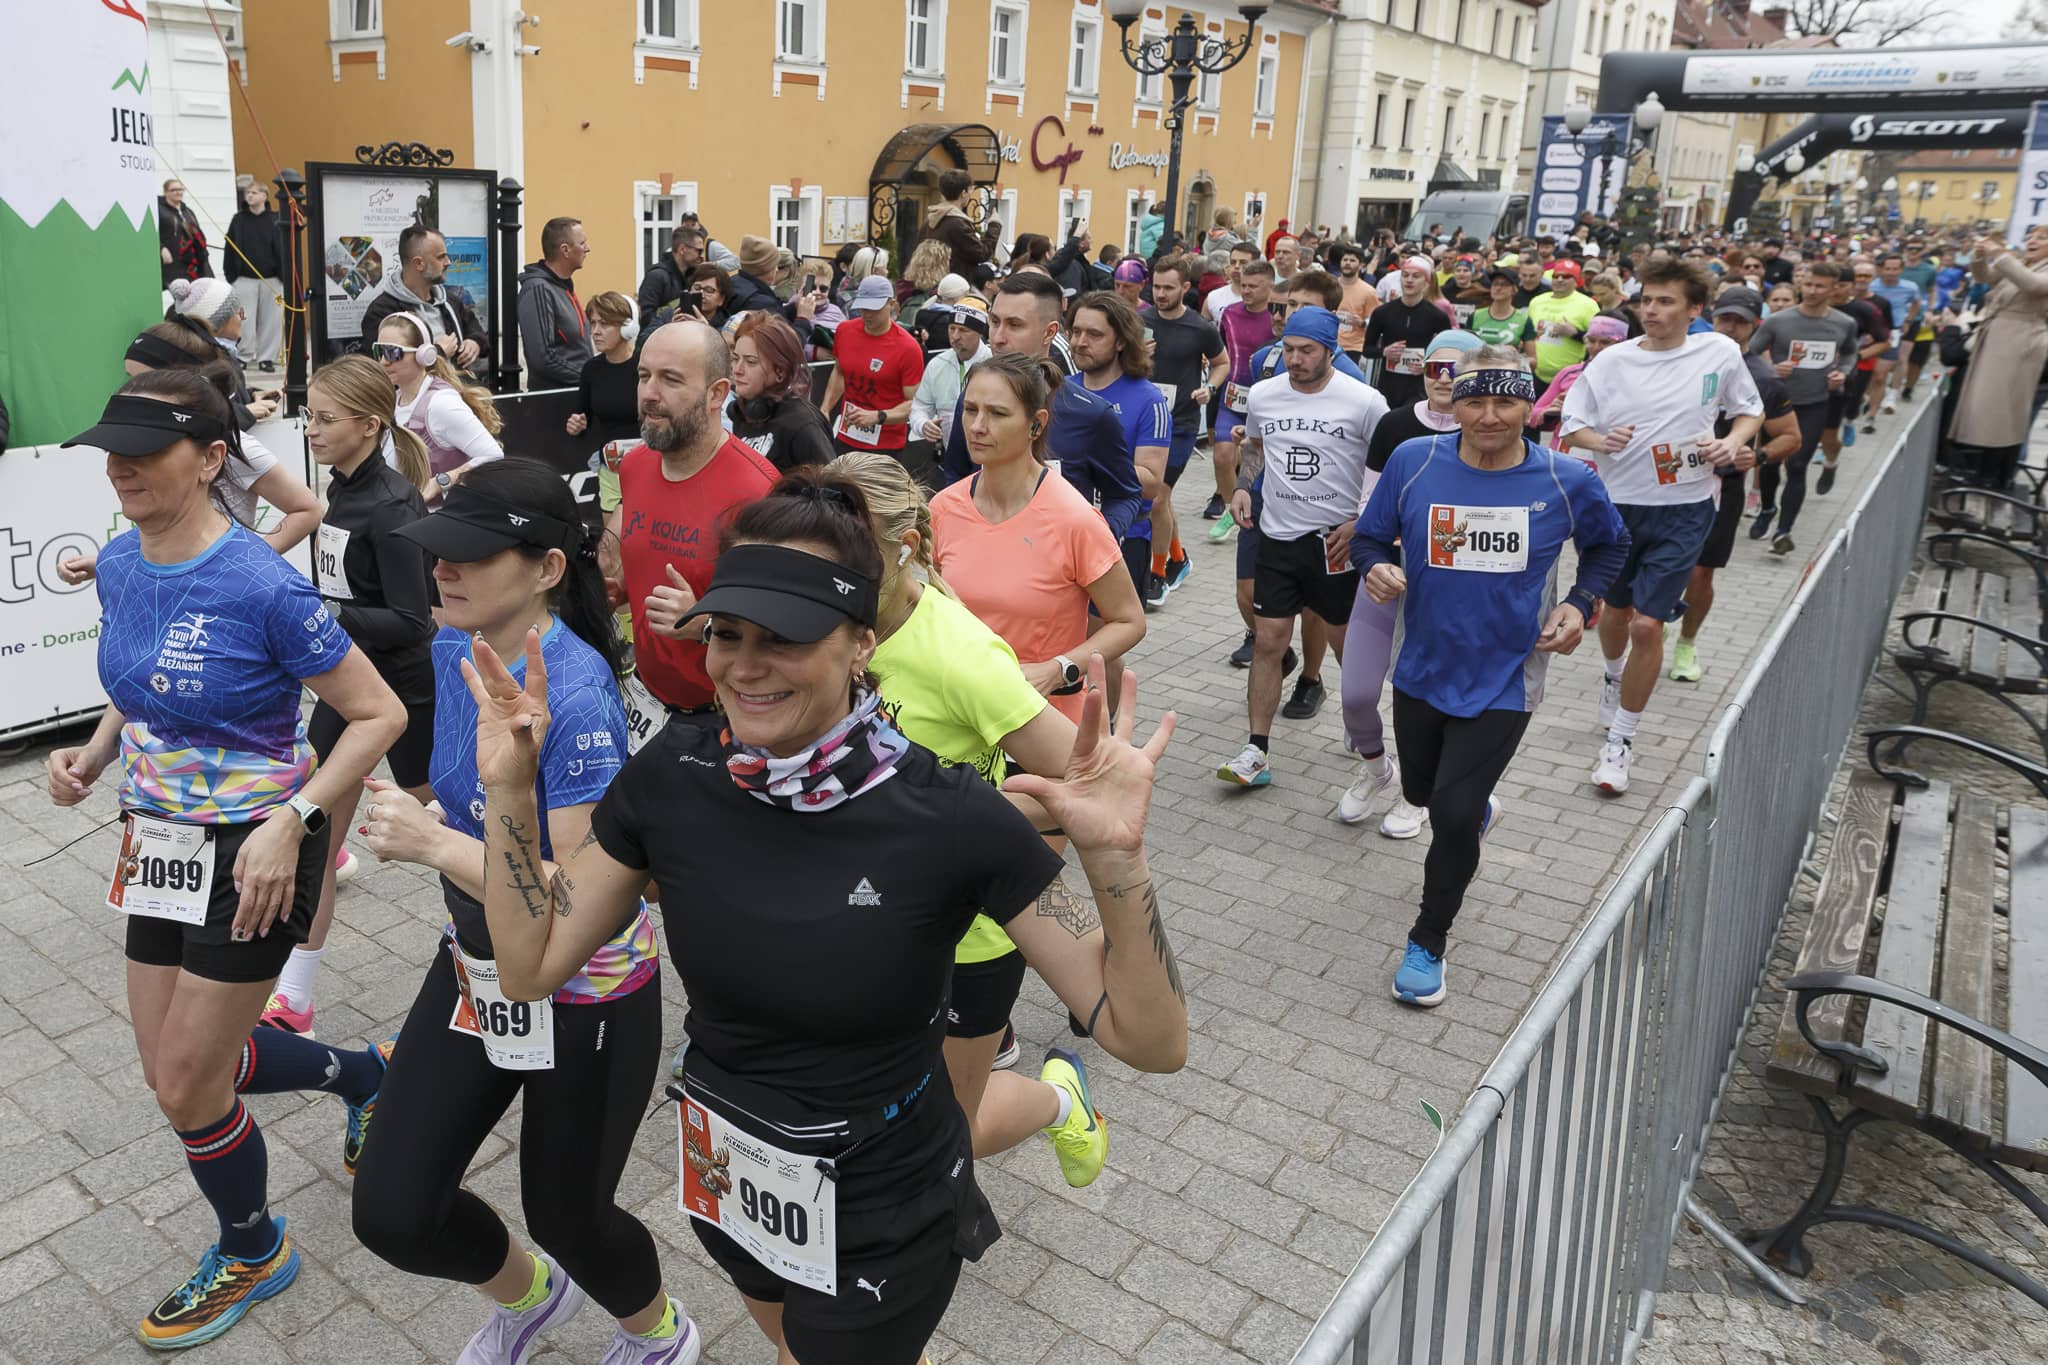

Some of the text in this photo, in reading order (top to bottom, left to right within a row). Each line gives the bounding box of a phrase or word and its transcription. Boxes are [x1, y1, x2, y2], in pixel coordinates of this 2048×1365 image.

[1875, 118, 2007, 136] SCOTT
[1264, 418, 1347, 440] BUŁKA
[1275, 491, 1338, 502] BARBERSHOP
[651, 519, 700, 545] KOLKA
[1468, 531, 1521, 553] 1058
[320, 549, 337, 578] 812
[43, 624, 99, 649] Dorad
[168, 628, 191, 643] XVIII
[140, 856, 204, 893] 1099
[848, 893, 882, 905] PEAK
[475, 997, 531, 1037] 869
[739, 1176, 809, 1247] 990
